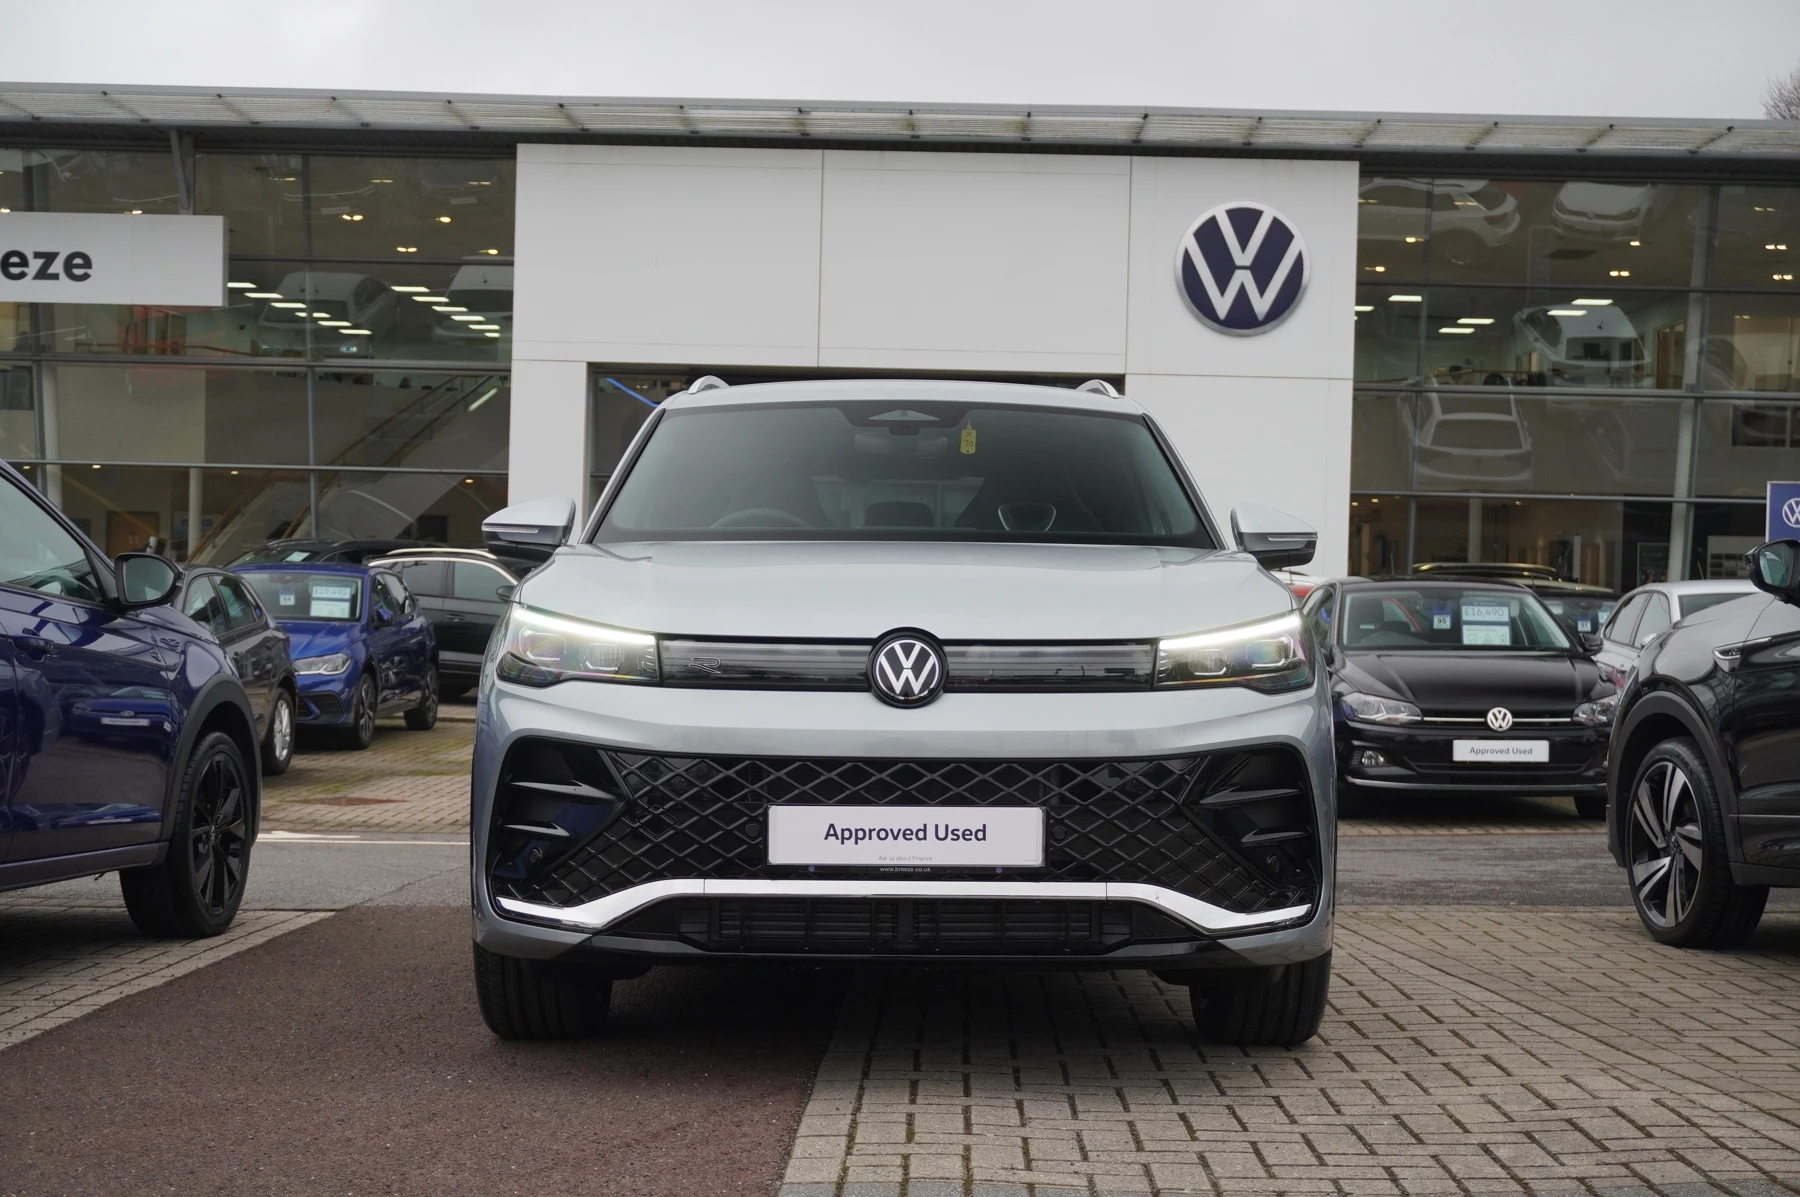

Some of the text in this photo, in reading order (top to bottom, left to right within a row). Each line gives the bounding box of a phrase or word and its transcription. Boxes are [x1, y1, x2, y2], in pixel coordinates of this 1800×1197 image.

[0, 249, 93, 282] eze
[1176, 202, 1309, 336] VW
[1464, 607, 1504, 617] £16,490
[876, 640, 939, 699] VW
[1487, 707, 1513, 731] VW
[1469, 747, 1510, 756] Approved
[824, 823, 987, 845] Approved Used
